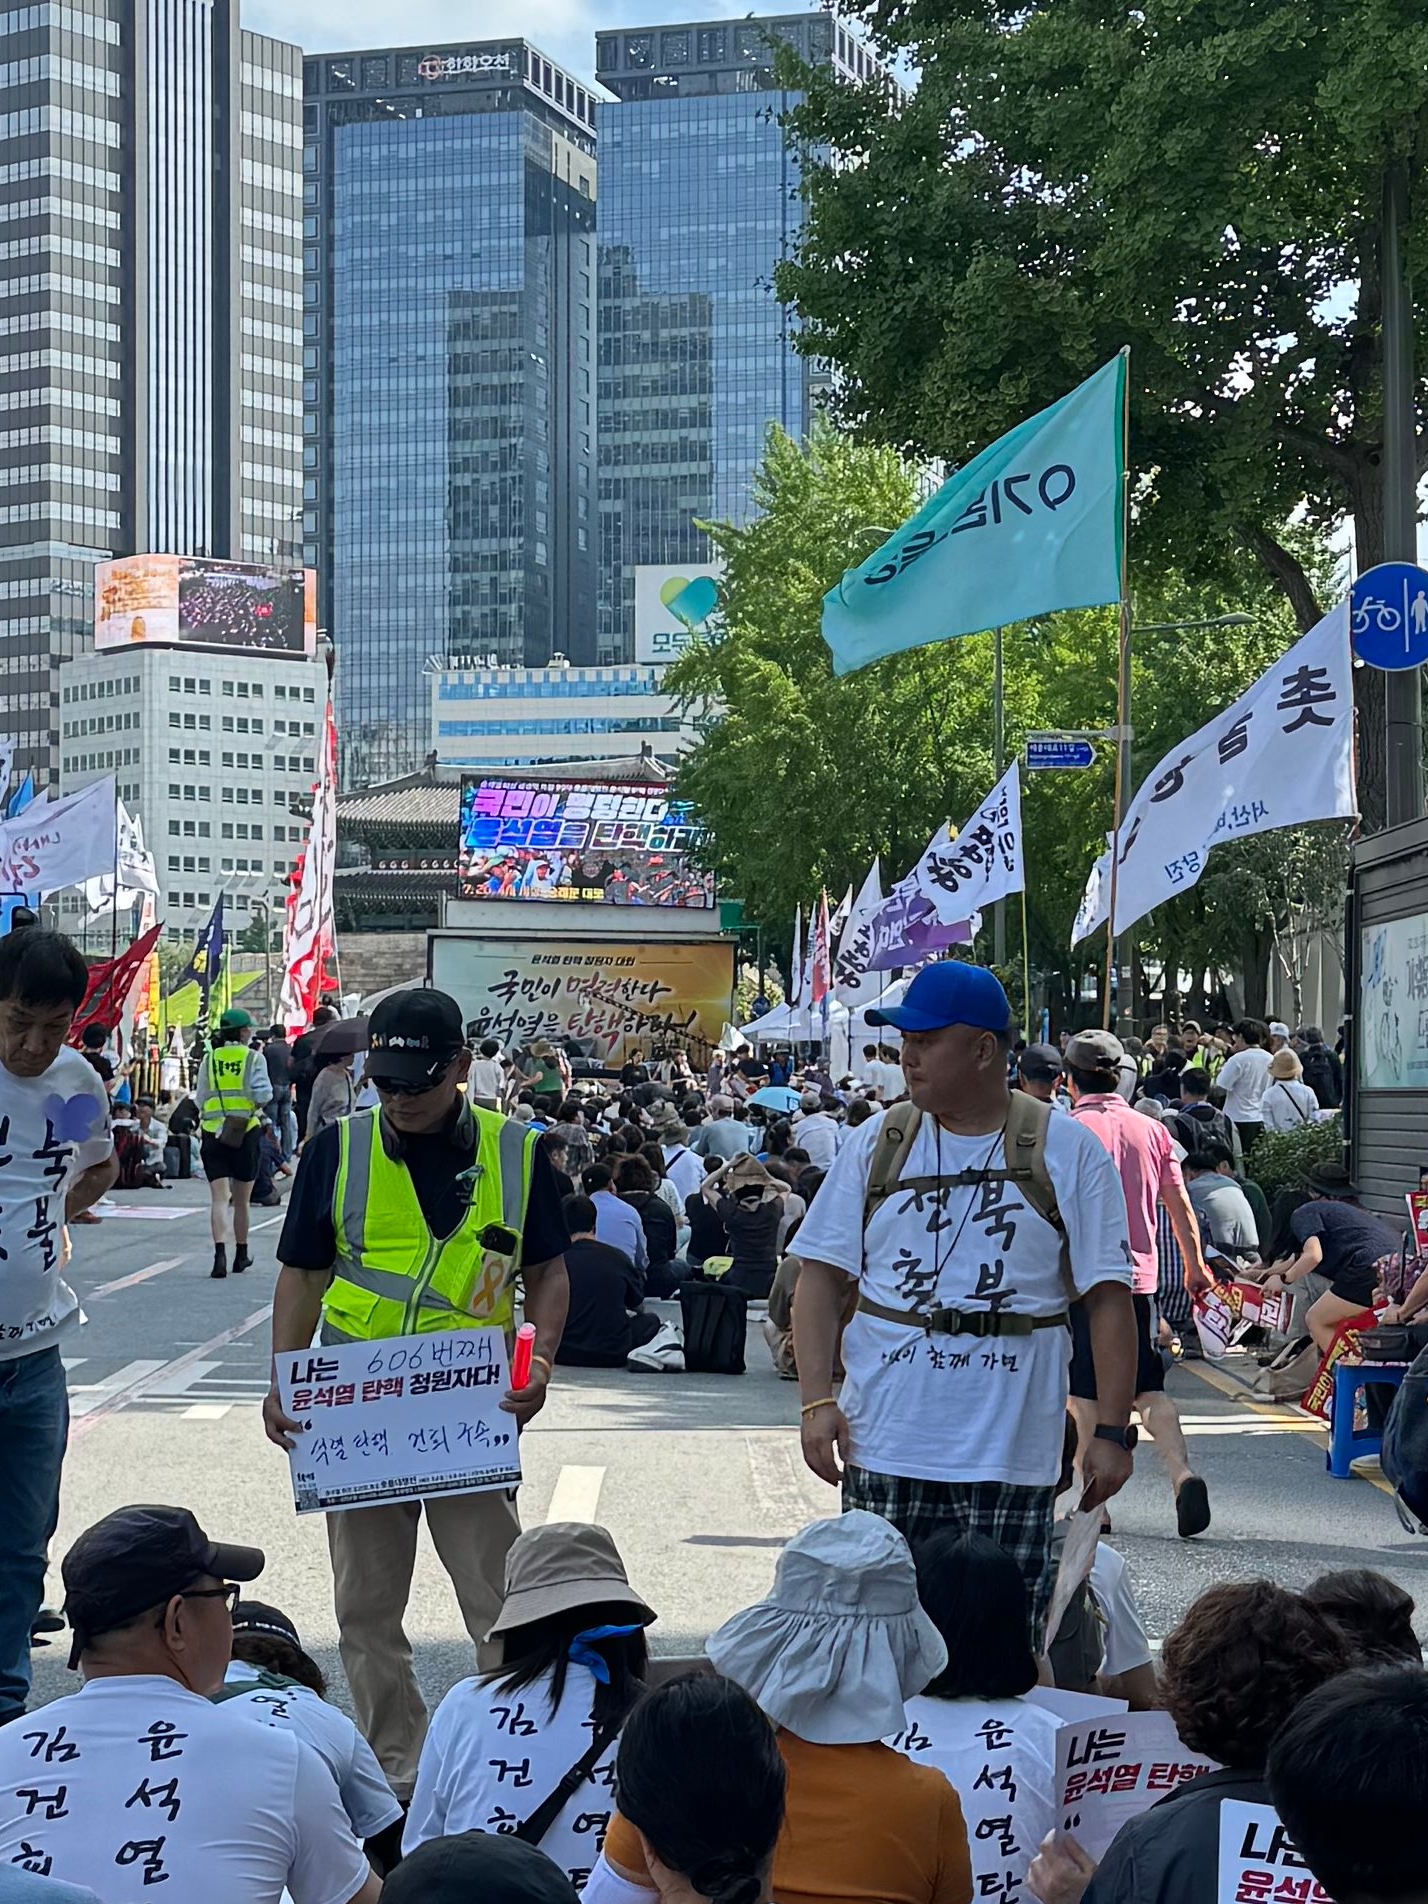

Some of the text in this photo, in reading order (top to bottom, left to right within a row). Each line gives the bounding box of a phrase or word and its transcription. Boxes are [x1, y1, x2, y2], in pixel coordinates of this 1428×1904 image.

[472, 788, 558, 818] 국민이
[487, 969, 562, 1006] 국민이
[290, 1358, 339, 1385] 나는
[927, 1345, 1019, 1372] 함께 가면
[292, 1364, 500, 1412] 윤석열 탄핵 청원자다!
[1068, 1728, 1125, 1771] 나는
[1063, 1761, 1142, 1804] 윤석열
